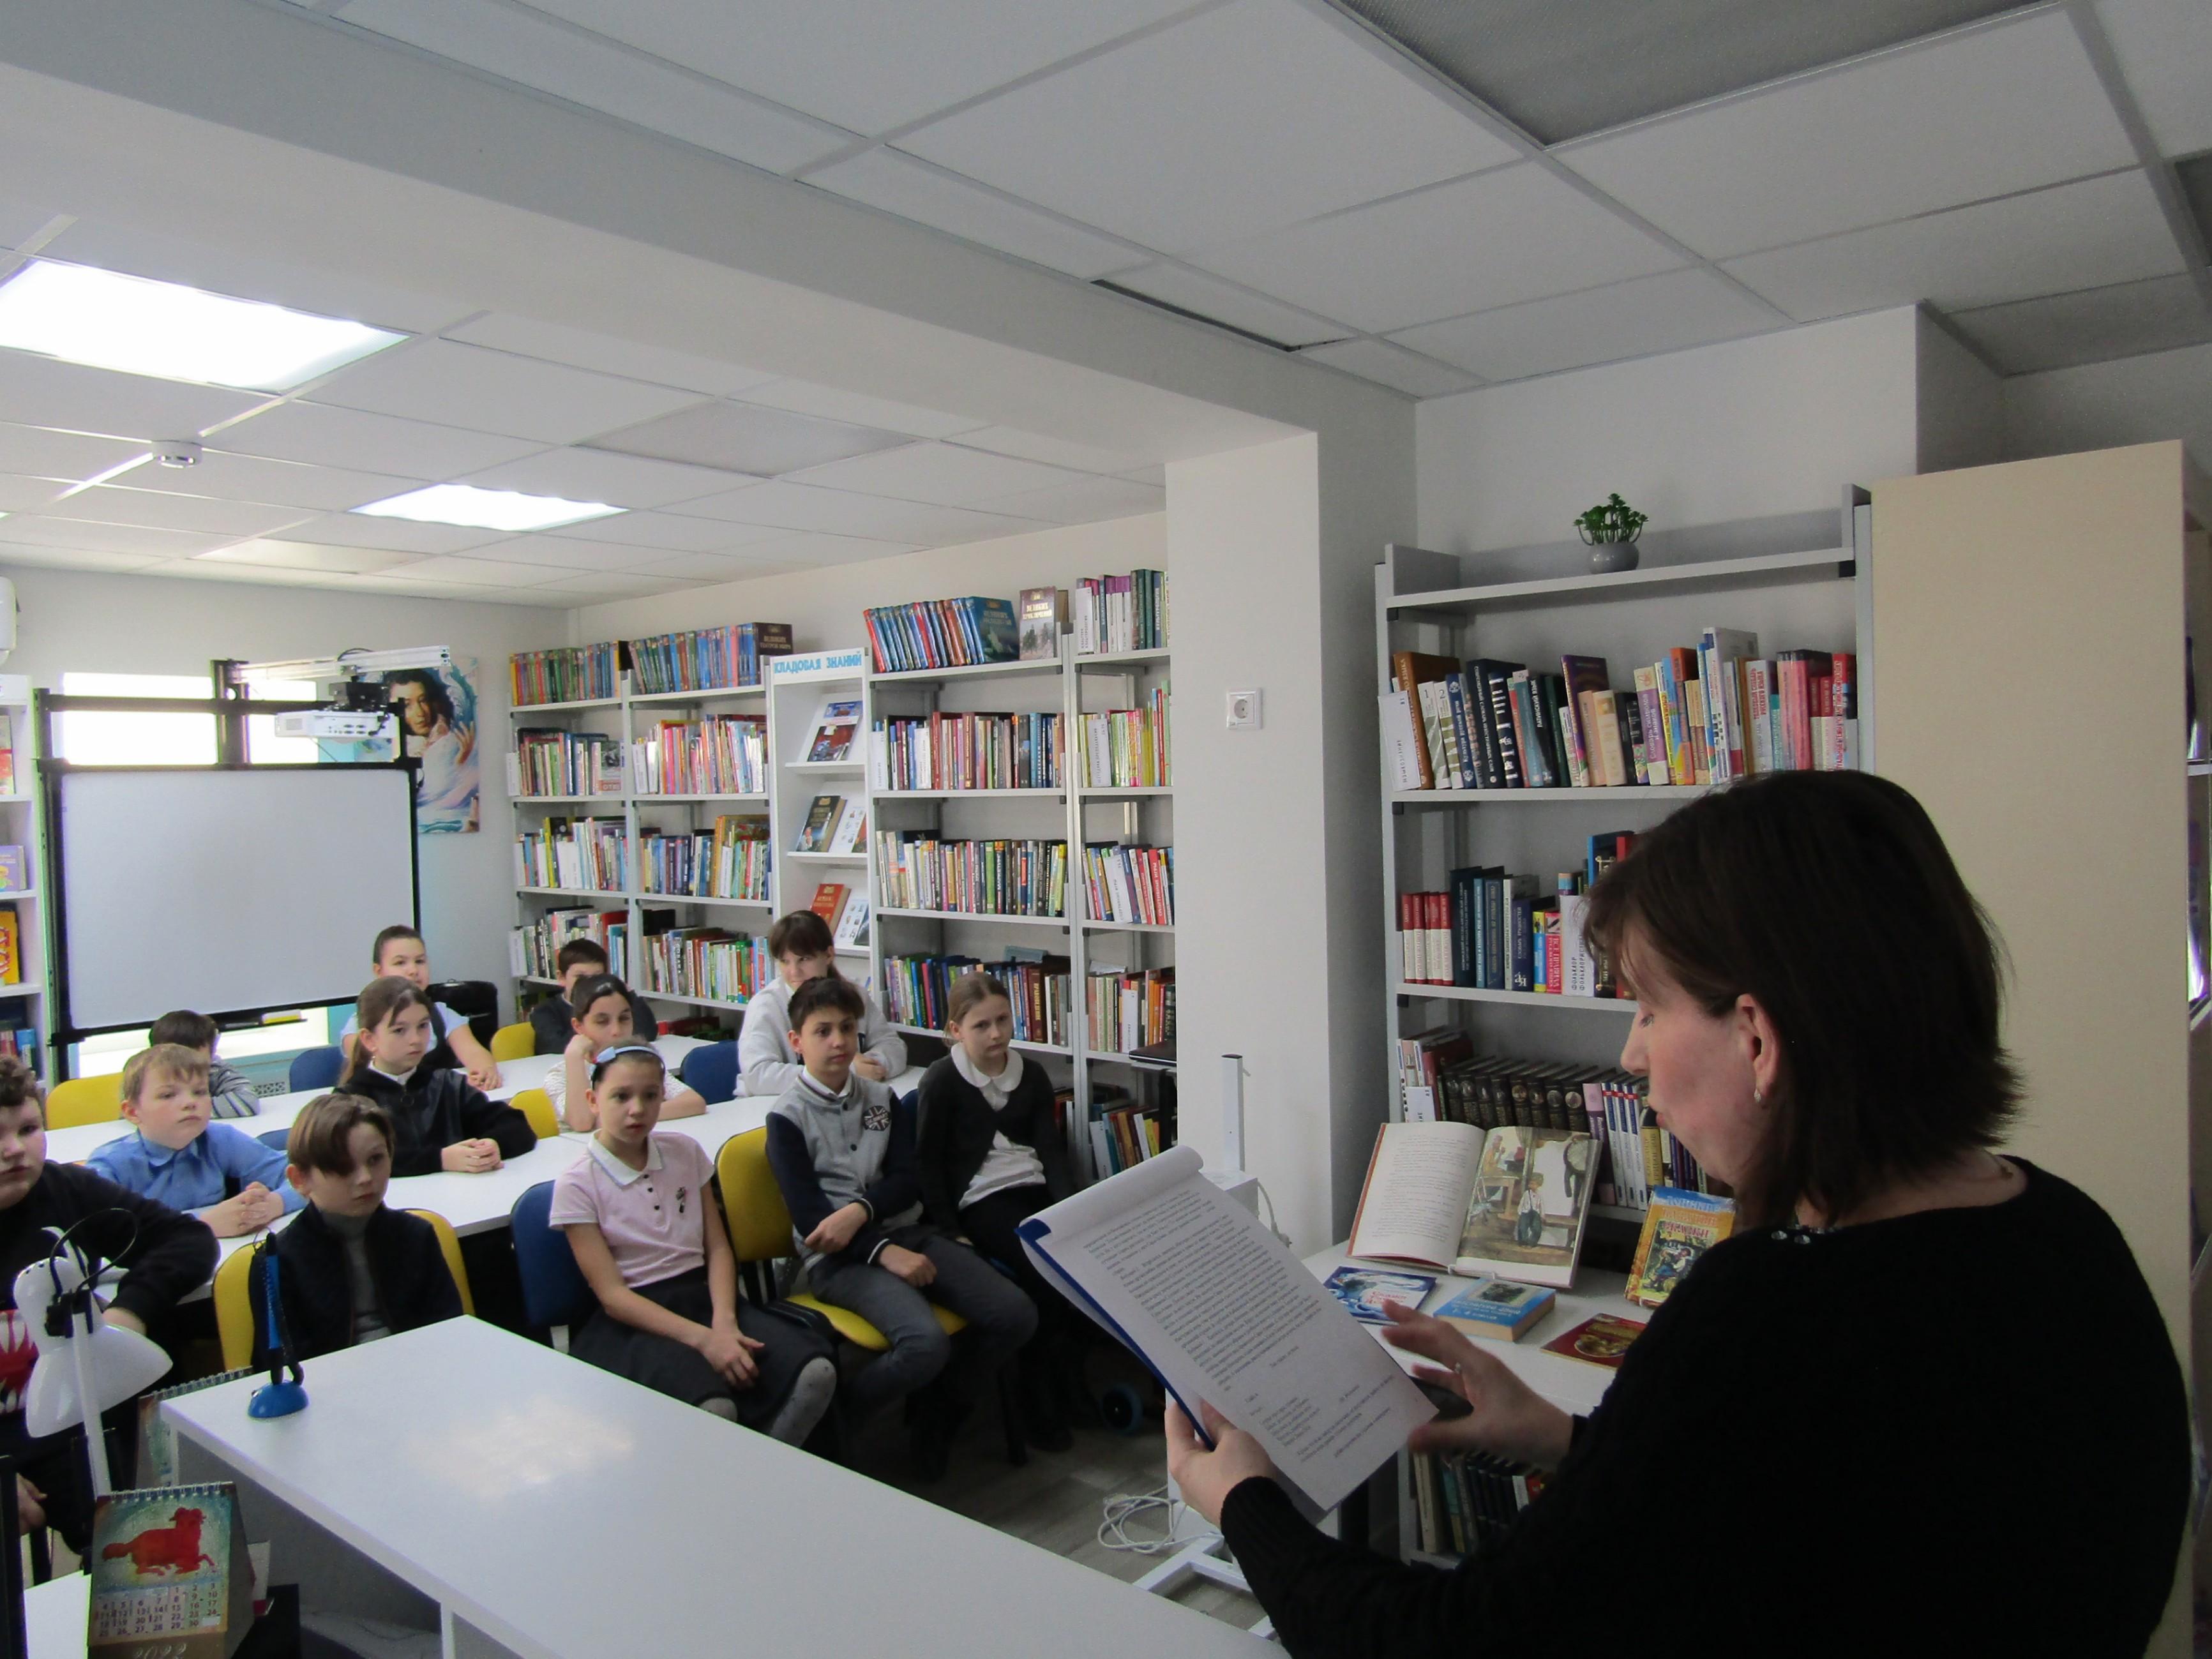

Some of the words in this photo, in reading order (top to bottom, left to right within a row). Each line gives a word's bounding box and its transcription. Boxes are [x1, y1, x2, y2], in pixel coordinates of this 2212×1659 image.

[774, 658, 822, 675] КЛАДОВАЯ
[826, 650, 862, 669] ЗНАНИЙ
[1424, 689, 1429, 698] 1
[1439, 689, 1445, 699] 2
[1531, 679, 1539, 694] ЯЗЫК
[1531, 694, 1543, 728] ЛАТИНСКИЙ
[1642, 693, 1653, 729] символов
[1752, 691, 1760, 719] ТОЛКОВЫЙ
[1650, 709, 1659, 733] знаков
[1459, 737, 1469, 763] Культура
[1648, 730, 1657, 759] Словарь
[1396, 739, 1408, 783] ЯЗЫКОЗНАНИЕ
